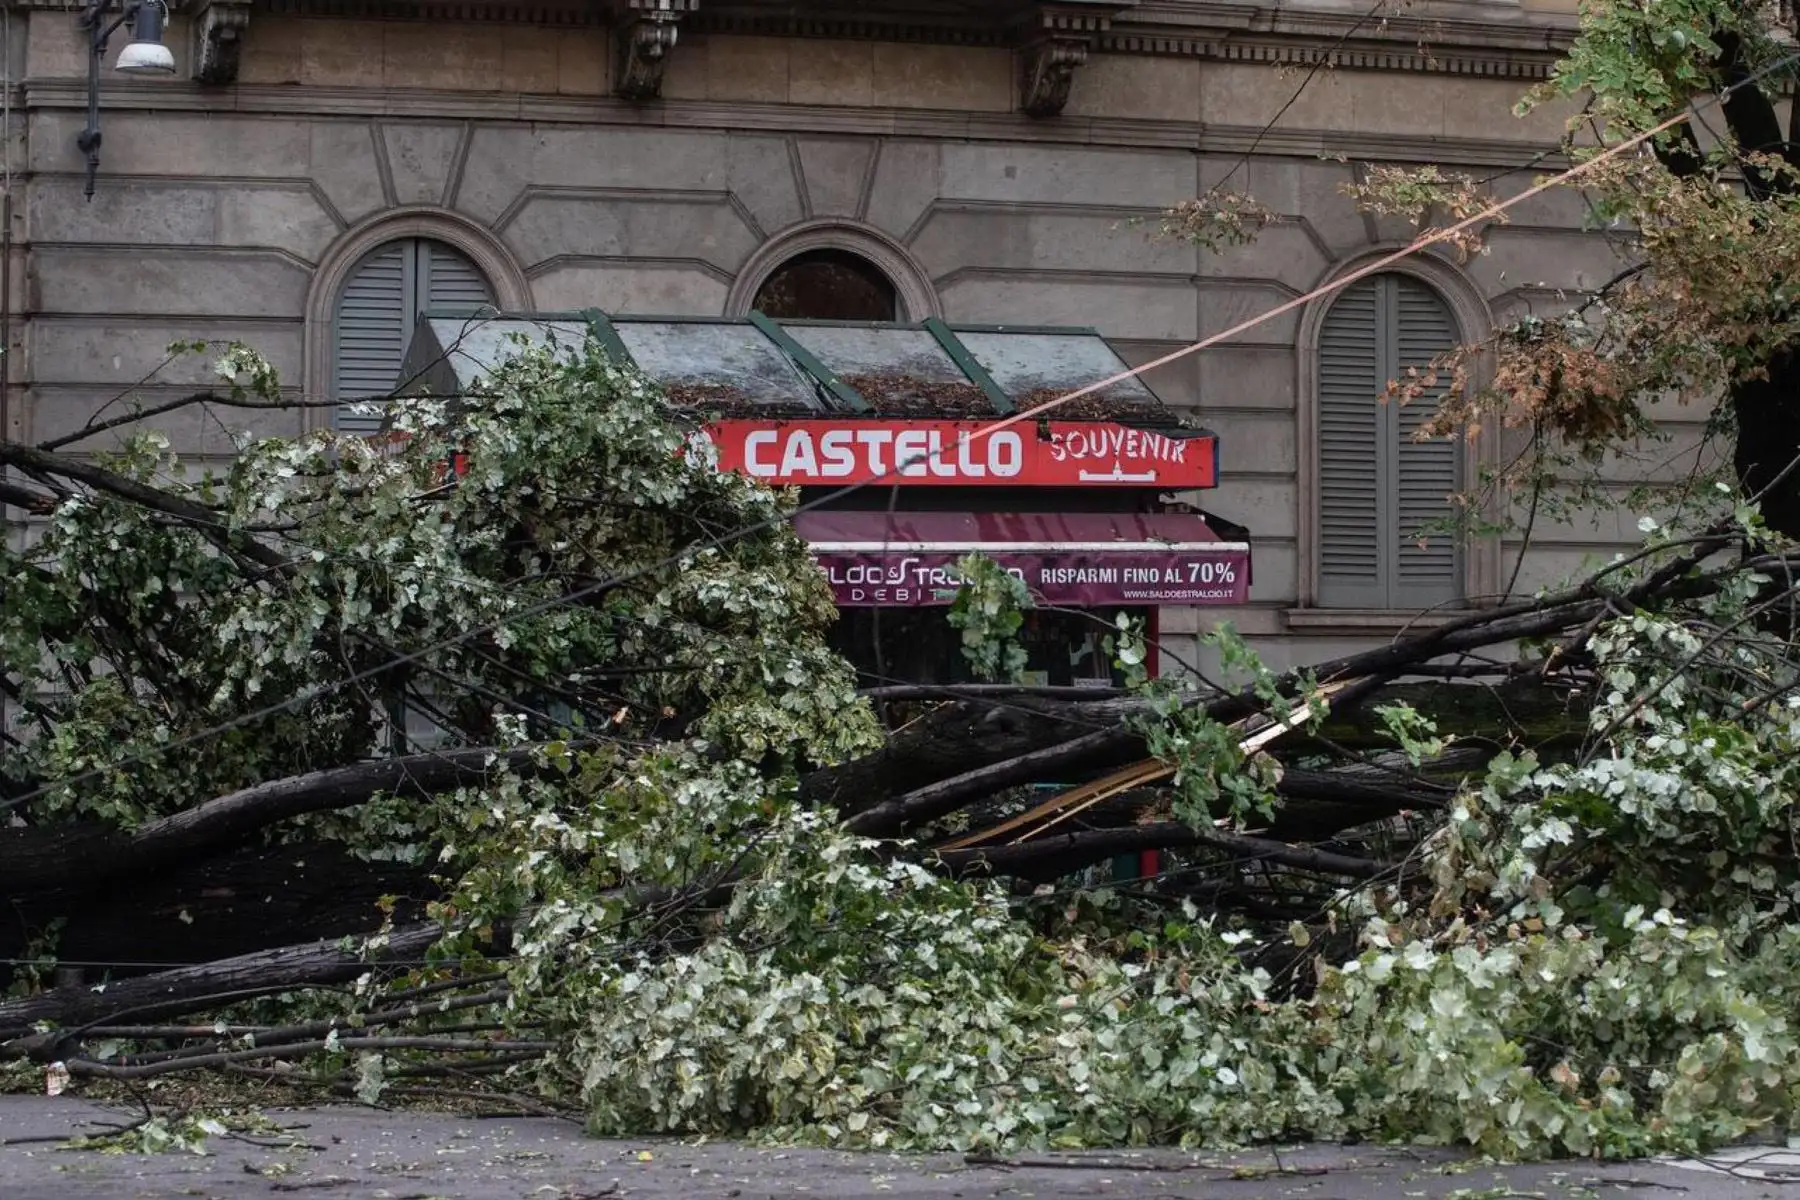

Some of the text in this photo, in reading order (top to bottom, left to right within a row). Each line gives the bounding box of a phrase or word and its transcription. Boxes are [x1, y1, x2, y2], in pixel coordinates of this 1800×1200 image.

[744, 430, 1022, 477] CASTELLO
[1050, 428, 1186, 464] SOUVENIR
[1041, 562, 1235, 584] RISPARMI FINO AL 70%
